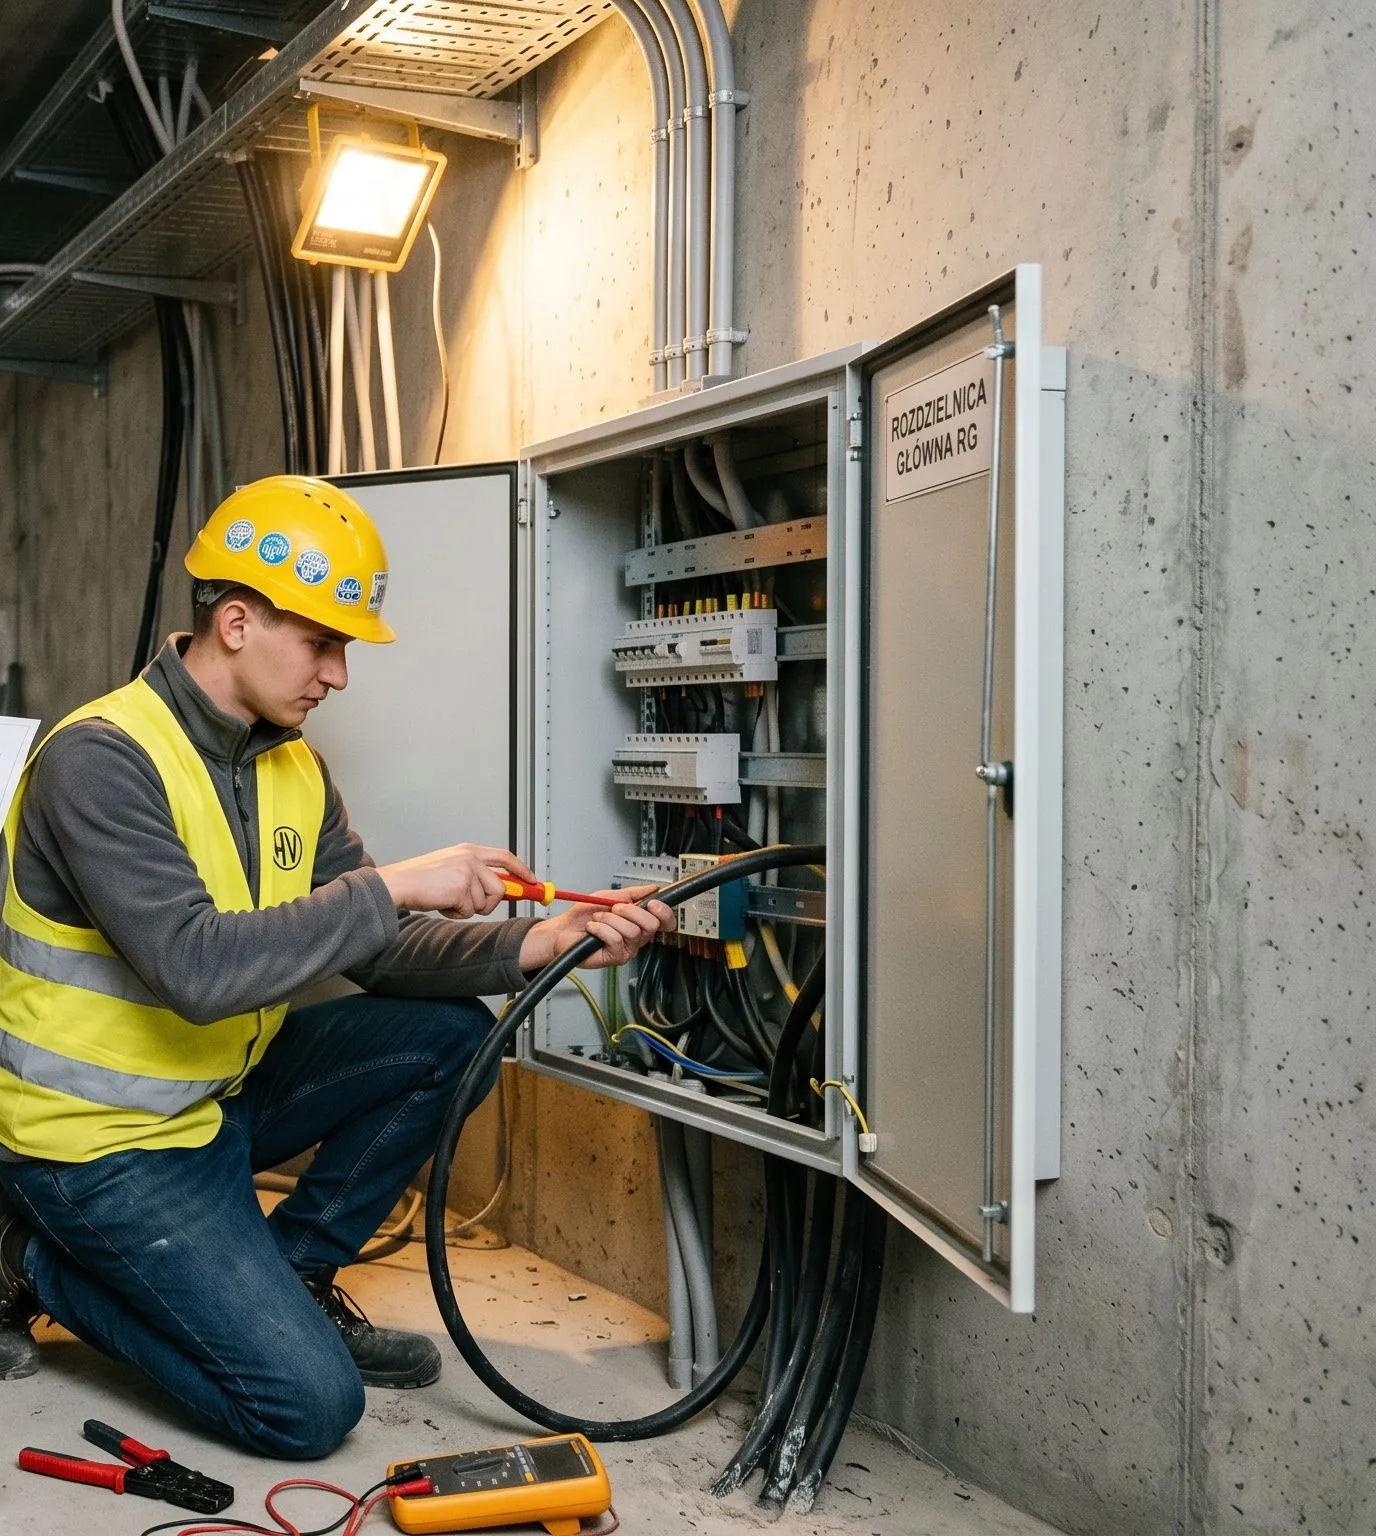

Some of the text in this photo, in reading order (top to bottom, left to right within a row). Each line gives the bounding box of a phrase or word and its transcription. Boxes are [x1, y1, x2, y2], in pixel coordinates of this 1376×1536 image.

[891, 378, 987, 442] ROZDZIELNICA
[896, 423, 978, 475] GŁÓWNA RG
